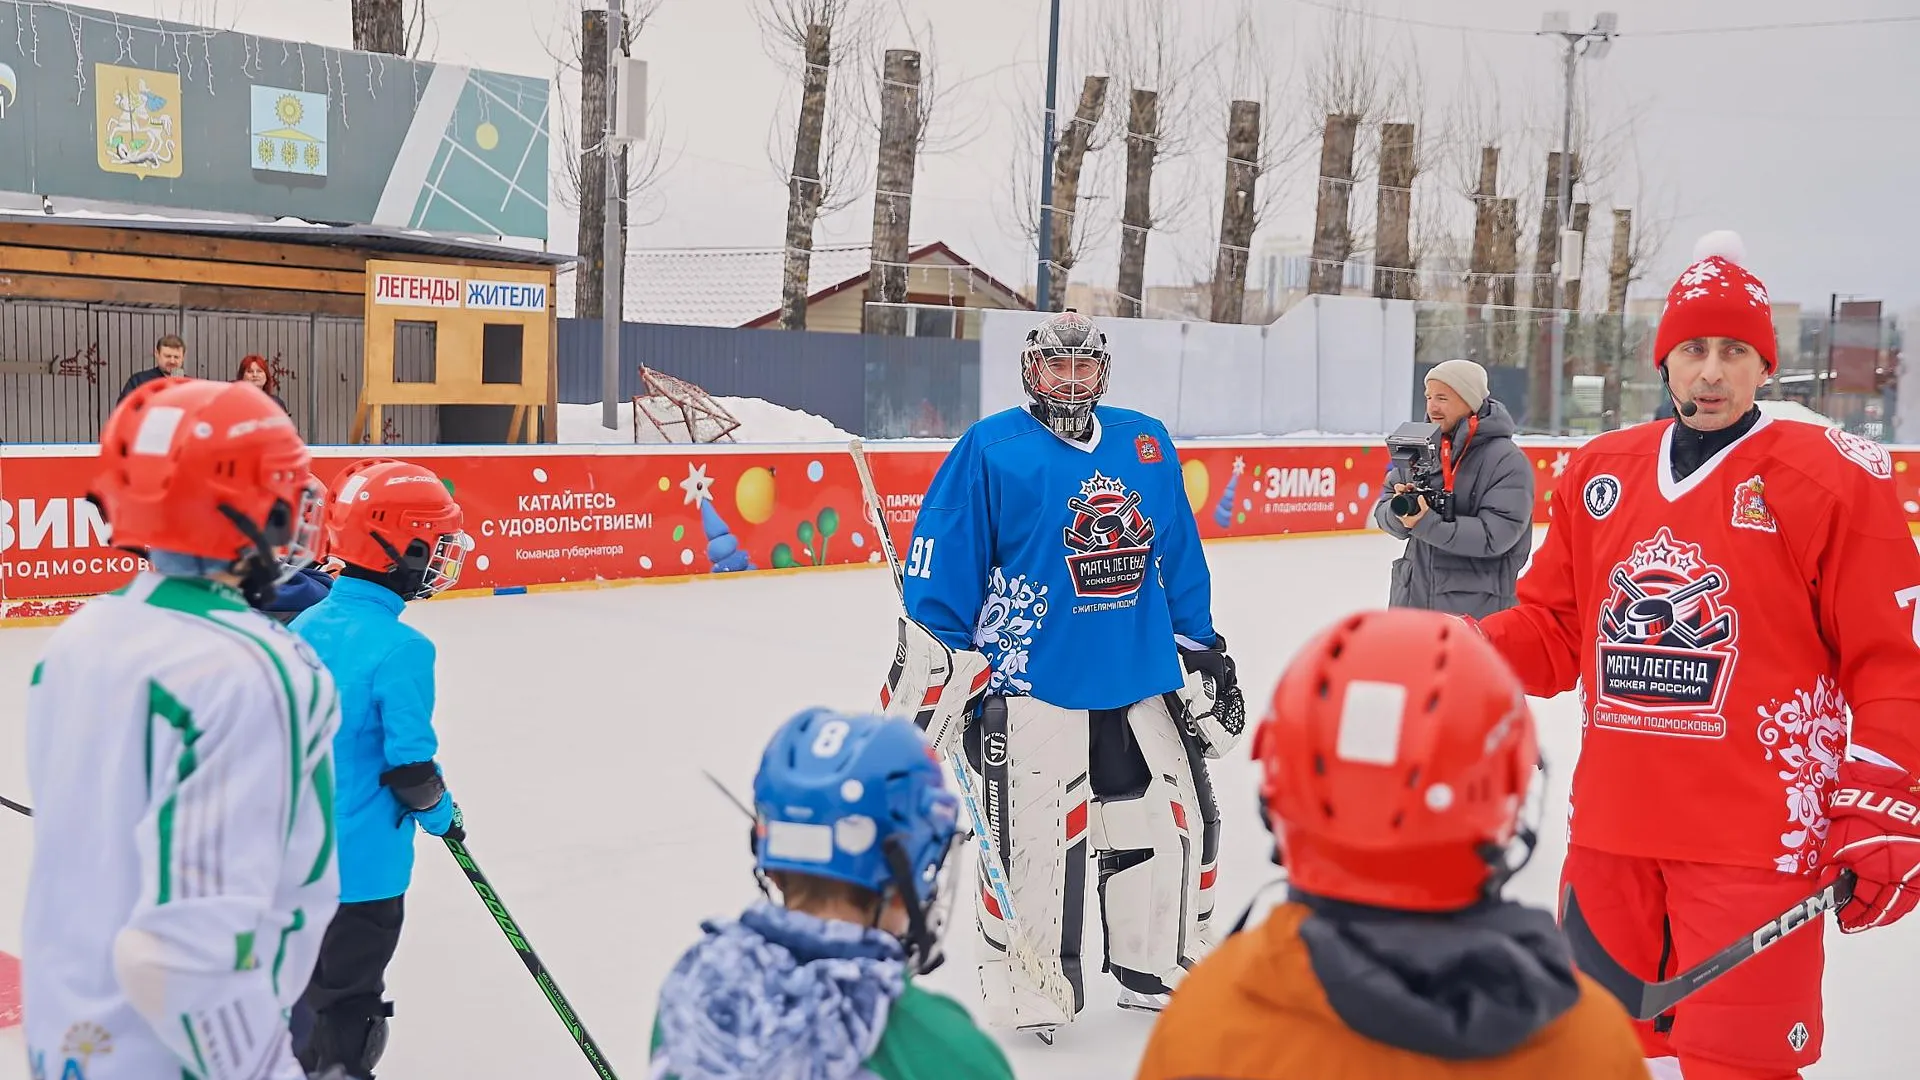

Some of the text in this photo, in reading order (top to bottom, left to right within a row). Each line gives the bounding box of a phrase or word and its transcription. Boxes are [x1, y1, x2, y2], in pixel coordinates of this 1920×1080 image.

[377, 276, 459, 305] ЛЕГЕНДЫ
[468, 284, 544, 308] ЖИТЕЛИ
[518, 490, 616, 512] КАТАЙТЕСЬ
[481, 513, 653, 538] С УДОВОЛЬСТВИЕМ!
[886, 508, 920, 523] ПОДМ
[516, 544, 624, 561] Команда губернатора
[907, 536, 935, 579] 91
[1080, 554, 1146, 577] МАТЧ ЛЕГЕНД
[1085, 576, 1116, 586] ХОККЕЯ
[1115, 599, 1137, 611] ПОДМ
[1606, 655, 1708, 683] МАТЧ ЛЕГЕНД
[1609, 678, 1701, 695] ХОККЕЯ РОССИИ
[1595, 710, 1721, 733] С ЖИТЕЛЯМИ ПОДМОСКОВЬЯ
[812, 720, 850, 758] 8
[473, 881, 531, 953] CODE
[1753, 885, 1835, 953] CCM
